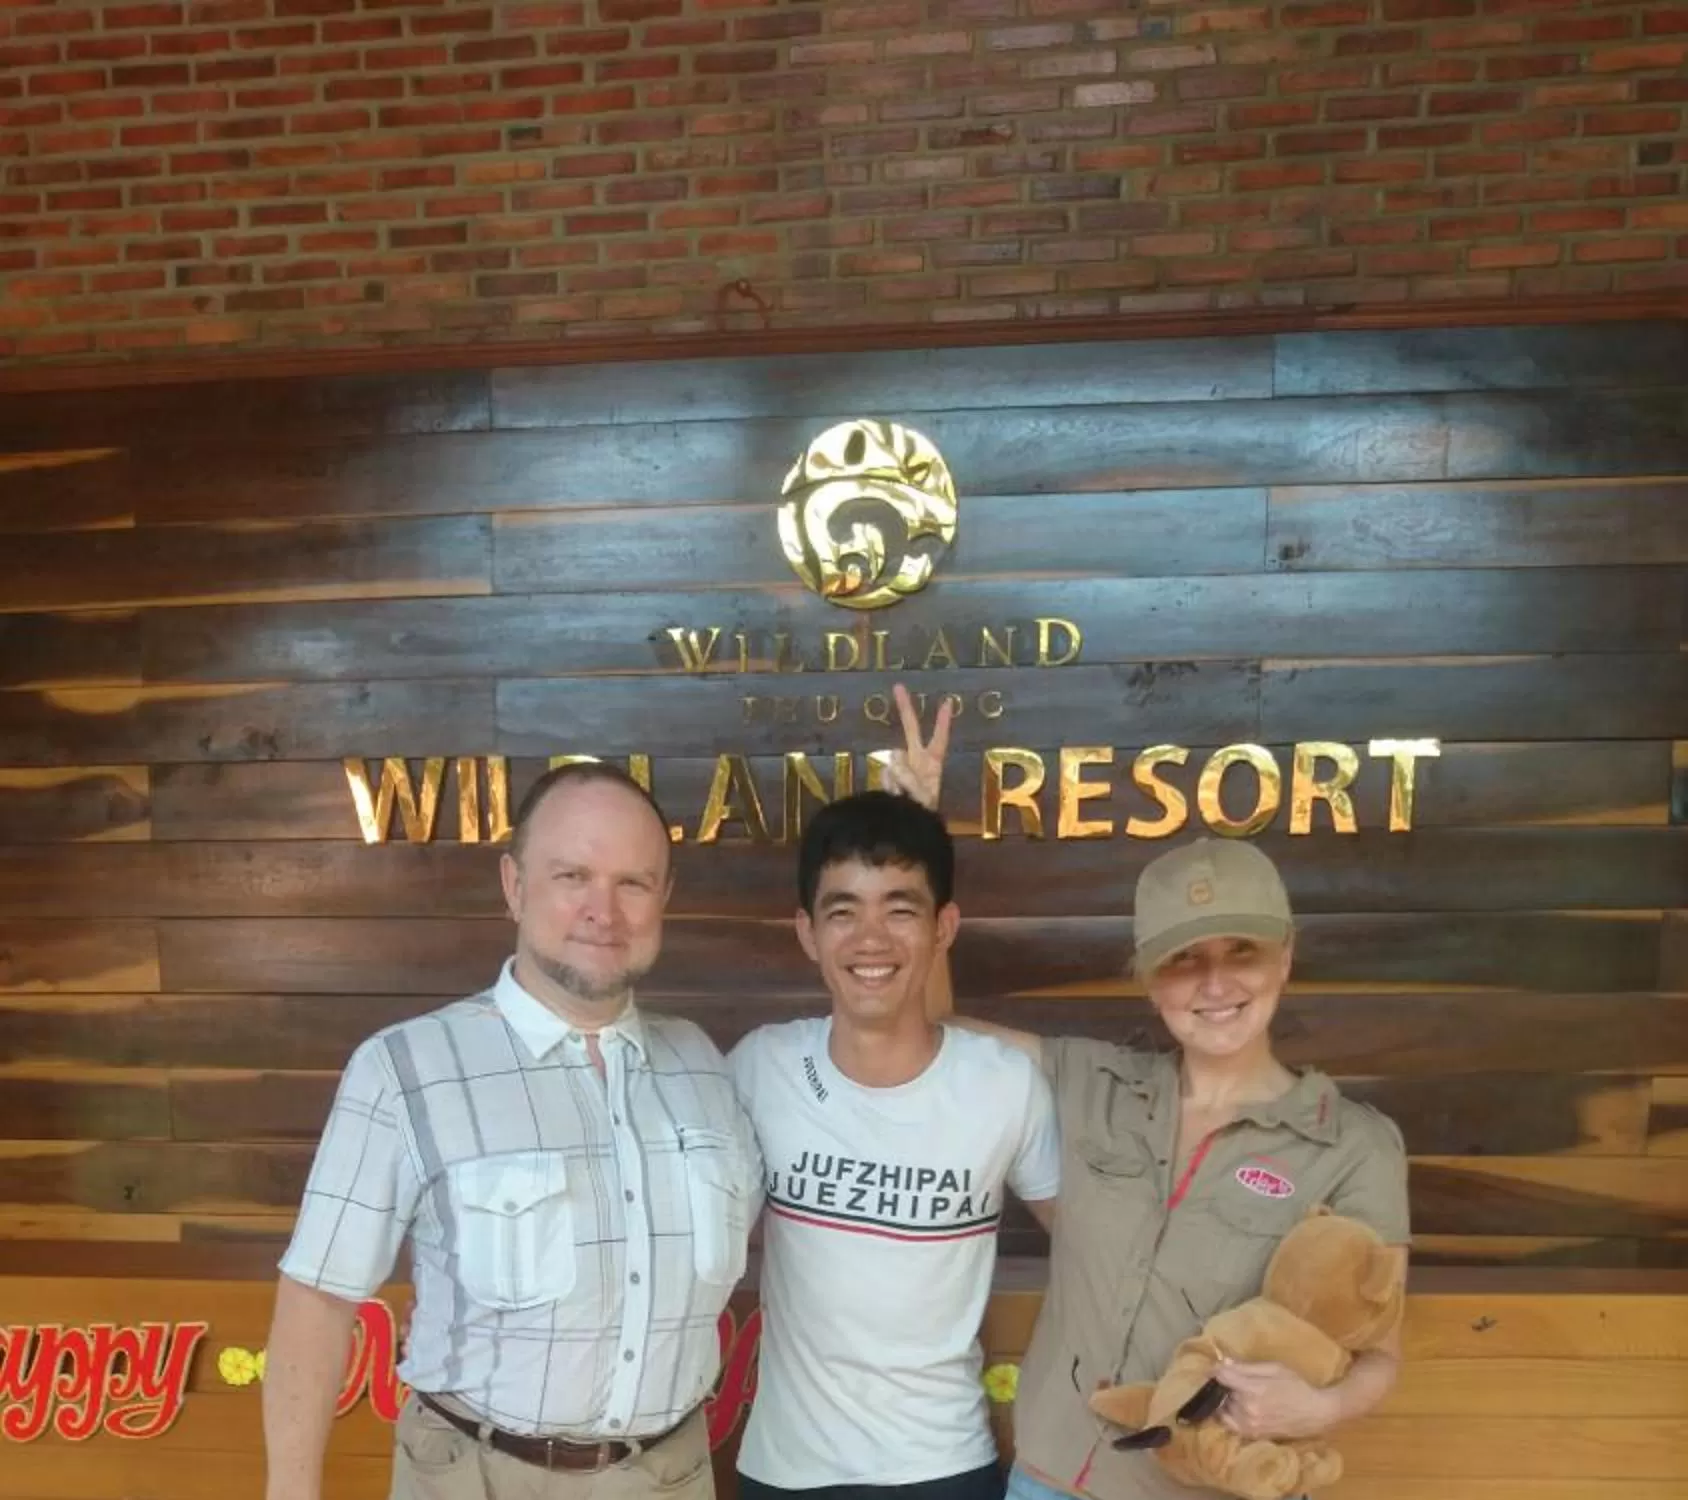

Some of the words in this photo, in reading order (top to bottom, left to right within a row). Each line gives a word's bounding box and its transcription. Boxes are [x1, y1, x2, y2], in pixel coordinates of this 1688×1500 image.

[666, 617, 1083, 674] WILDLAND
[342, 750, 892, 844] WILAN
[982, 738, 1441, 840] RESORT
[769, 1171, 990, 1220] JUEZHIPAI
